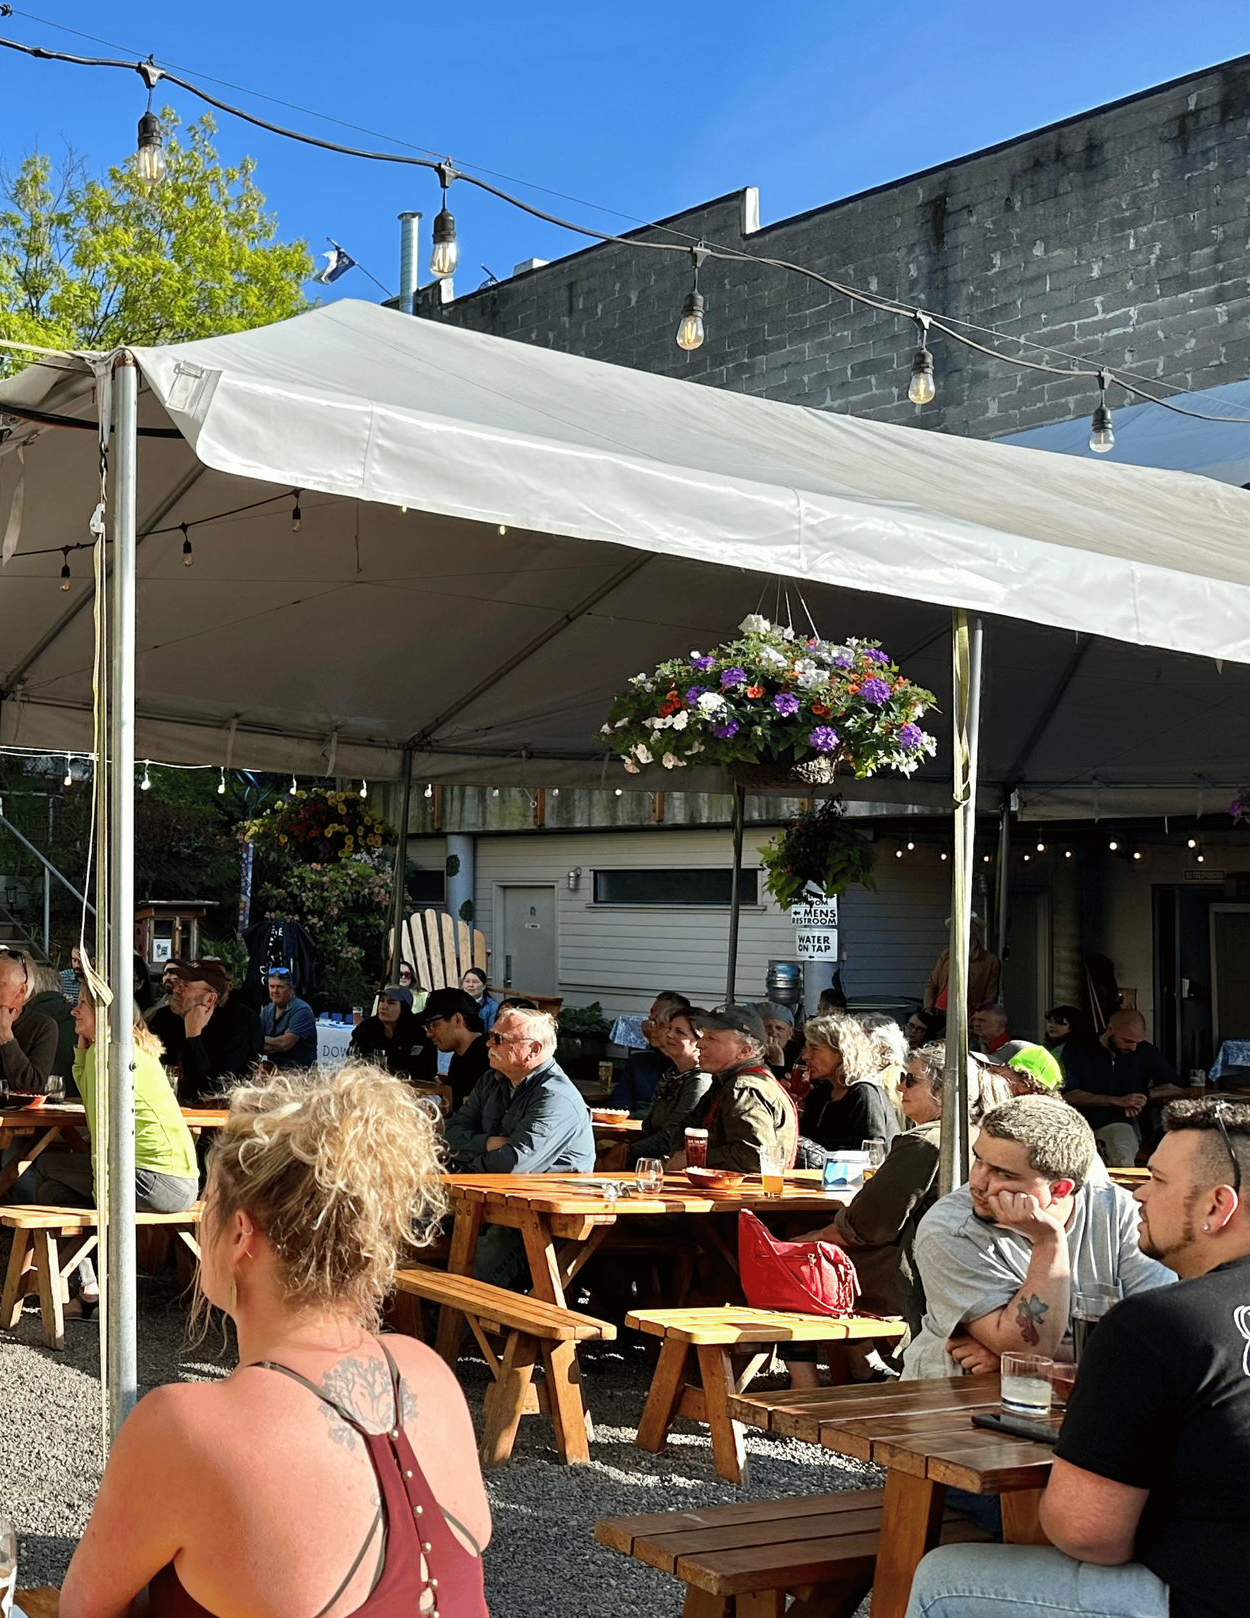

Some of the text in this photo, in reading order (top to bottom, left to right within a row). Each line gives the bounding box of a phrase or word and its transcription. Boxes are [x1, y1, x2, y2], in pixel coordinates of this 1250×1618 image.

[803, 909, 836, 918] MENS
[792, 917, 837, 925] RESTROOM
[798, 935, 831, 945] WATER
[798, 944, 831, 953] ON TAP
